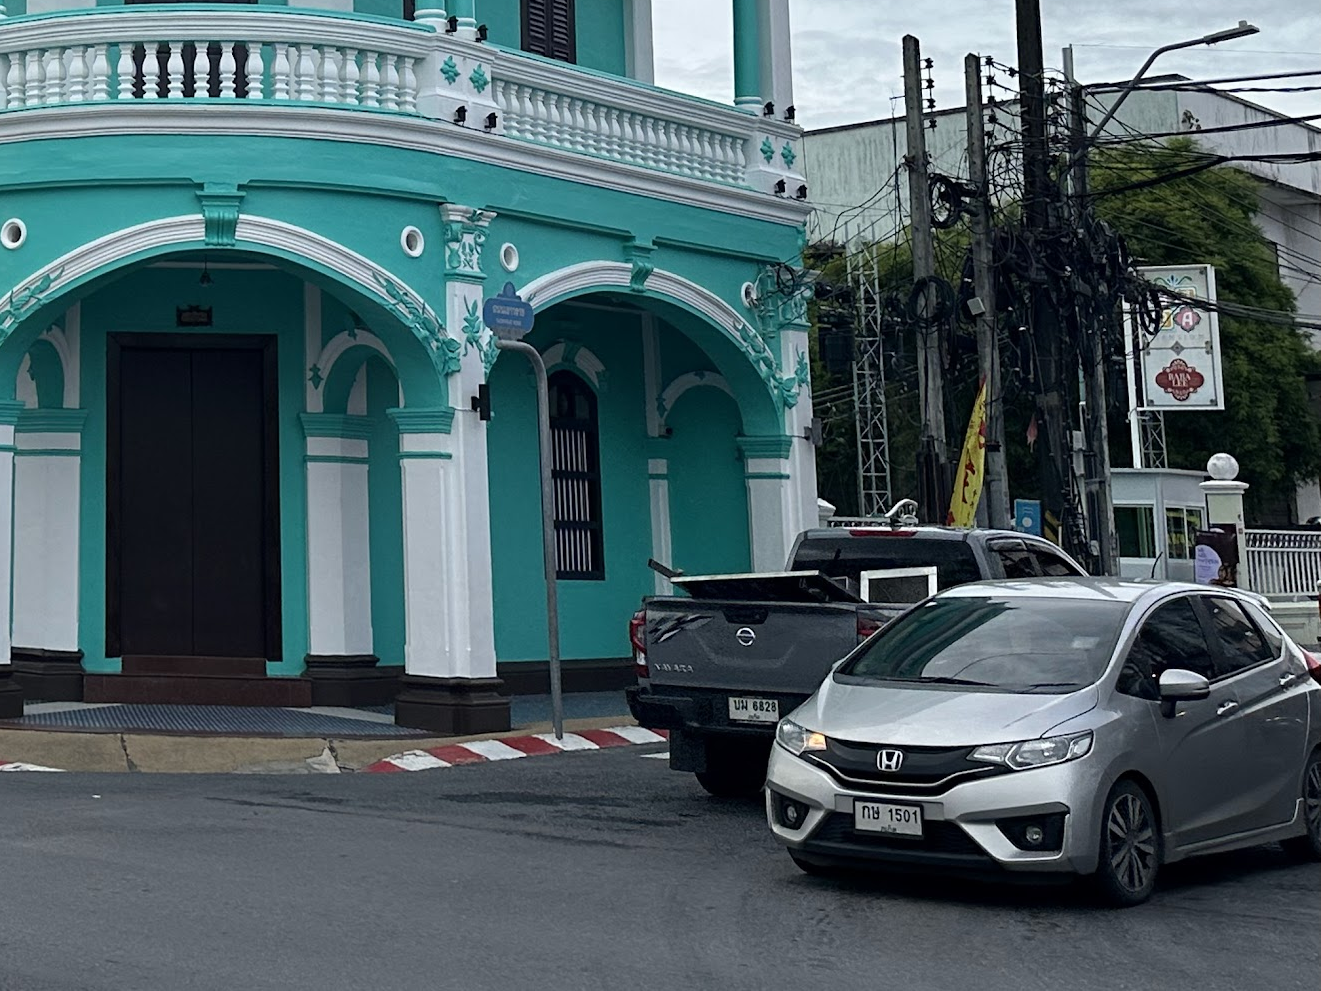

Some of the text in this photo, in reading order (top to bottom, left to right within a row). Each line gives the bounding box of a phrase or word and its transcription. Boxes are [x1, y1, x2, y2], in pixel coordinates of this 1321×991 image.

[753, 700, 777, 713] 6828
[862, 805, 918, 824] กษ 1501
